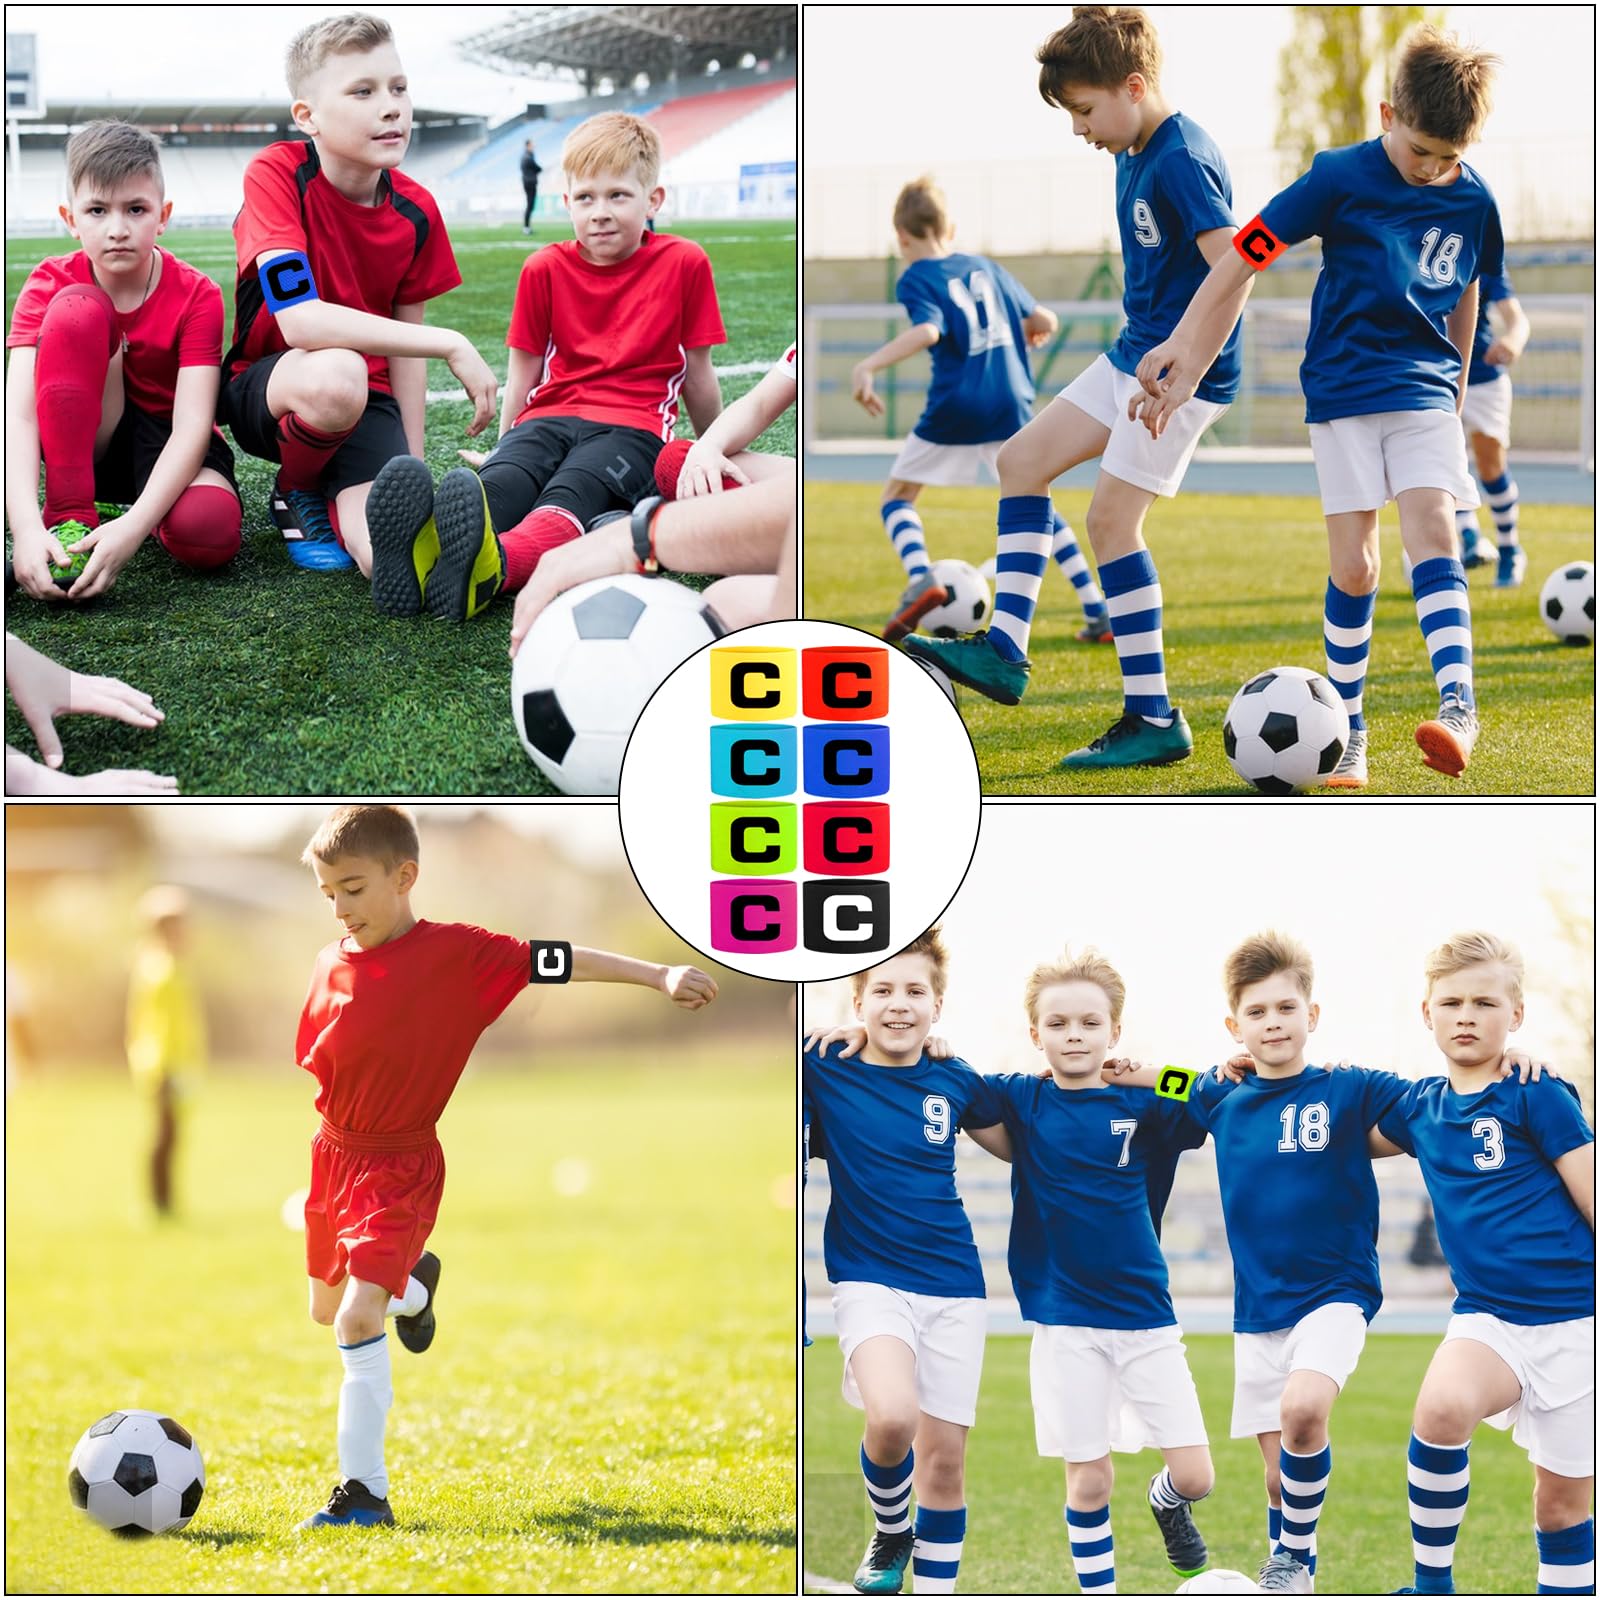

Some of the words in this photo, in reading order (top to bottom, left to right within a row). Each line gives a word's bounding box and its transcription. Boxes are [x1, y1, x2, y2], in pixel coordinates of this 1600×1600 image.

[1133, 199, 1161, 247] 9
[1242, 229, 1276, 263] C
[1418, 226, 1463, 286] 18
[266, 259, 311, 302] C
[730, 662, 781, 709] C
[822, 662, 873, 709] C
[730, 739, 781, 786] C
[823, 739, 873, 786] C
[730, 817, 781, 863] C
[823, 817, 873, 863] C
[730, 895, 781, 941] C
[823, 895, 873, 942] C
[537, 948, 565, 977] C
[1160, 1070, 1189, 1095] C
[922, 1094, 951, 1145] 9
[1110, 1118, 1138, 1168] 7
[1278, 1101, 1330, 1153] 18
[1471, 1117, 1506, 1171] 3
